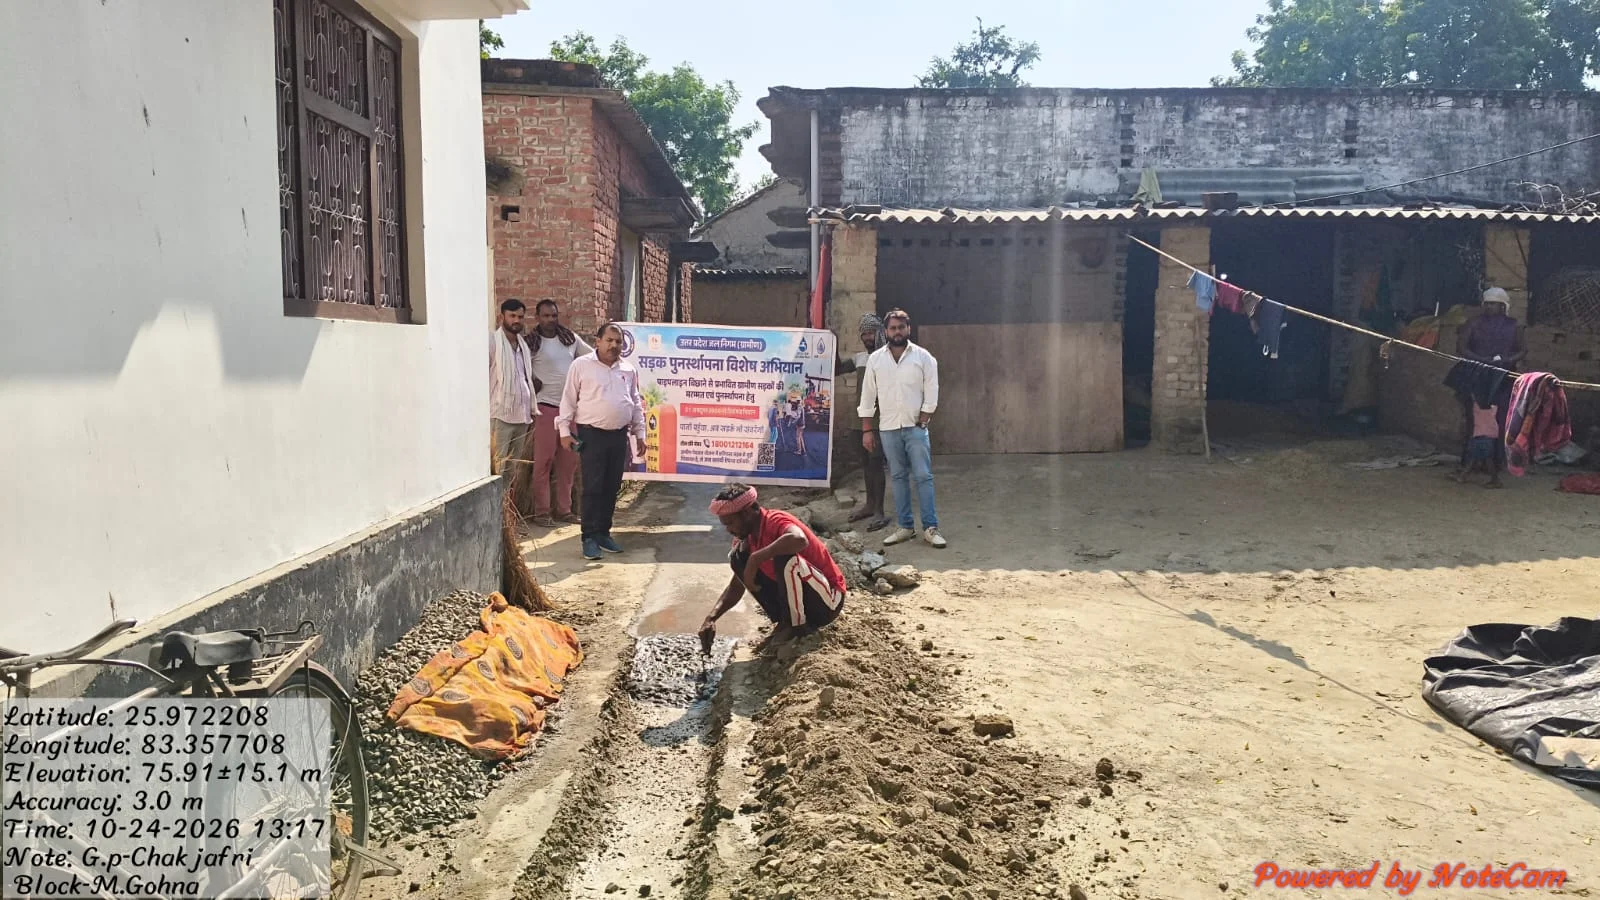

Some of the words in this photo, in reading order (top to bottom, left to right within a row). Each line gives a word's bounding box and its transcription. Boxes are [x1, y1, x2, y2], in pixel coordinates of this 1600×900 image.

[693, 337, 707, 348] प्रदेश
[709, 339, 719, 347] जल
[720, 338, 736, 348] निगम
[737, 338, 762, 350] (ग्रामीण)
[638, 355, 667, 372] सड़क
[669, 354, 723, 374] पुनर्स्थापना
[726, 355, 758, 374] विशेष
[760, 357, 803, 374] अभियान
[657, 378, 687, 388] पाइपलाइन
[688, 378, 707, 388] बिछाने
[708, 378, 714, 387] से
[714, 379, 737, 389] प्रभावित
[737, 379, 756, 389] ग्रामीण
[757, 380, 775, 392] सड़कों
[776, 381, 784, 391] की
[746, 392, 755, 403] हेतु
